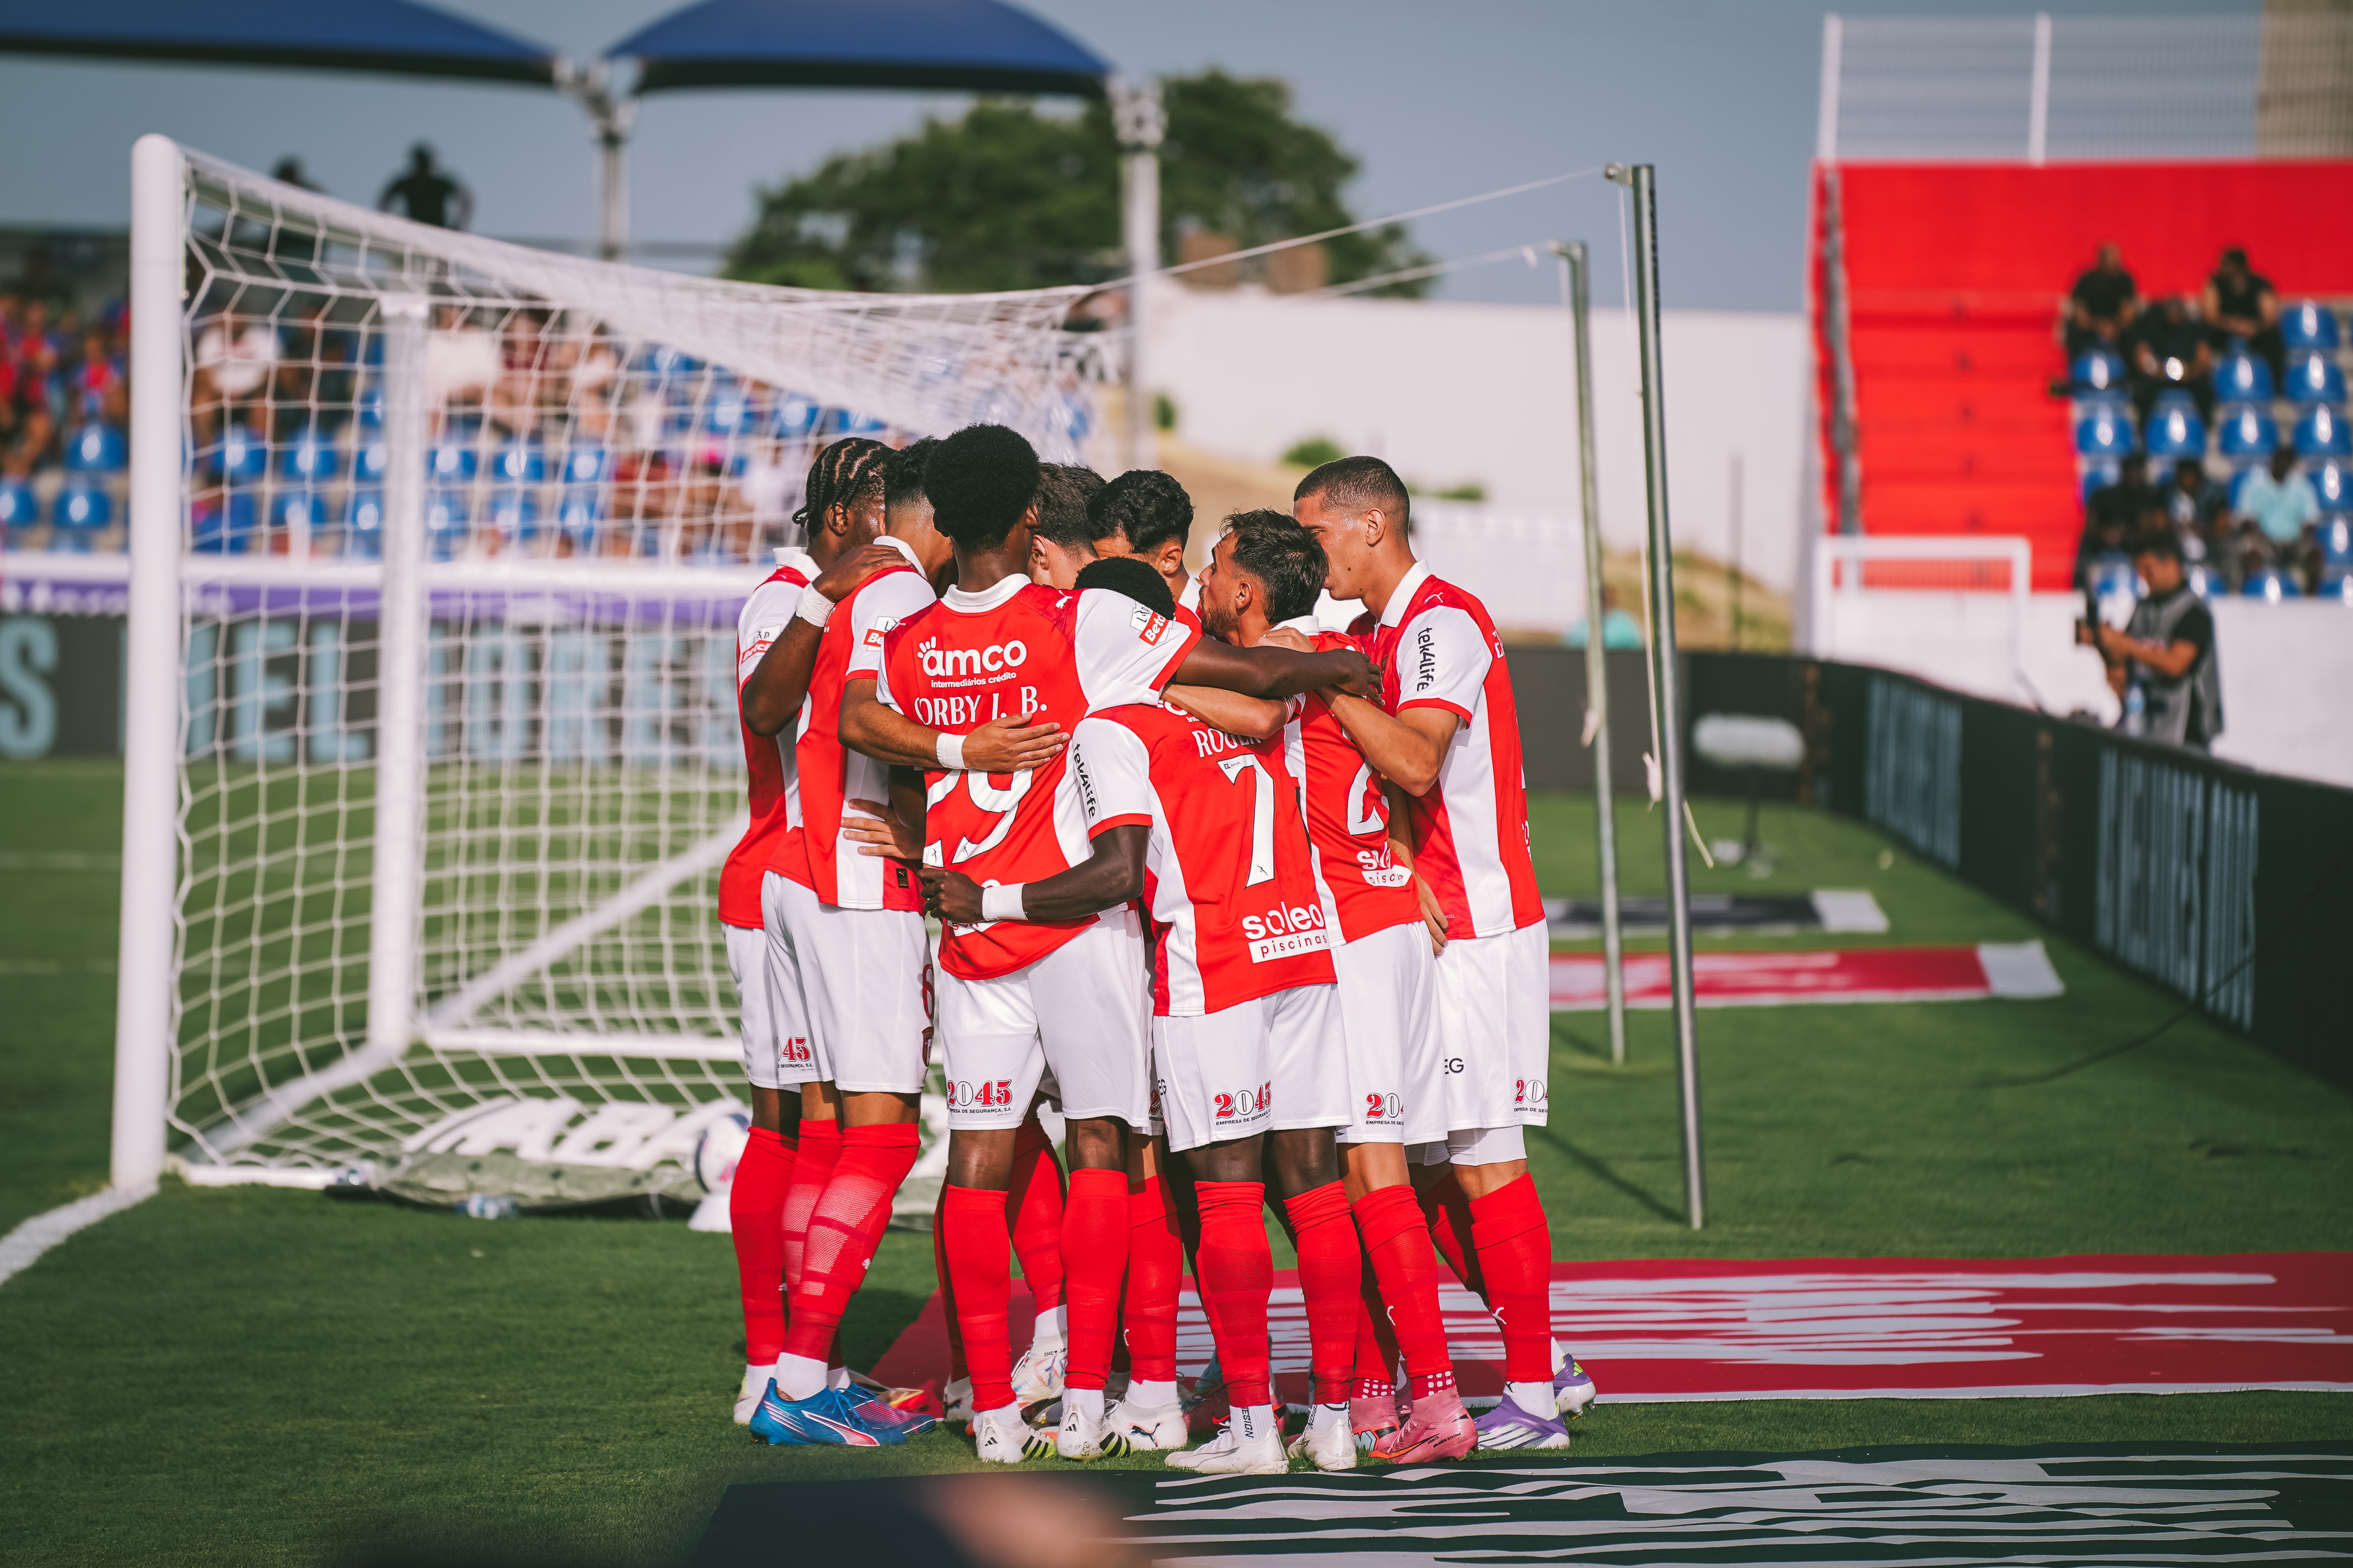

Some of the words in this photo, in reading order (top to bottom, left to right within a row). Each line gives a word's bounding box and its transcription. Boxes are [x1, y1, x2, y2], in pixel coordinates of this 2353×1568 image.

[922, 640, 1027, 677] amco
[1417, 627, 1435, 692] tek4life
[931, 676, 986, 688] intermediários
[988, 672, 1016, 684] crédito
[1020, 686, 1047, 715] B.
[1216, 753, 1275, 890] 7
[1242, 901, 1324, 940] soleo
[1260, 934, 1327, 958] piscinas
[778, 1036, 811, 1062] 45
[947, 1079, 1013, 1107] 2045
[1213, 1079, 1272, 1120] 2045
[1447, 1432, 1462, 1441] ZOOM
